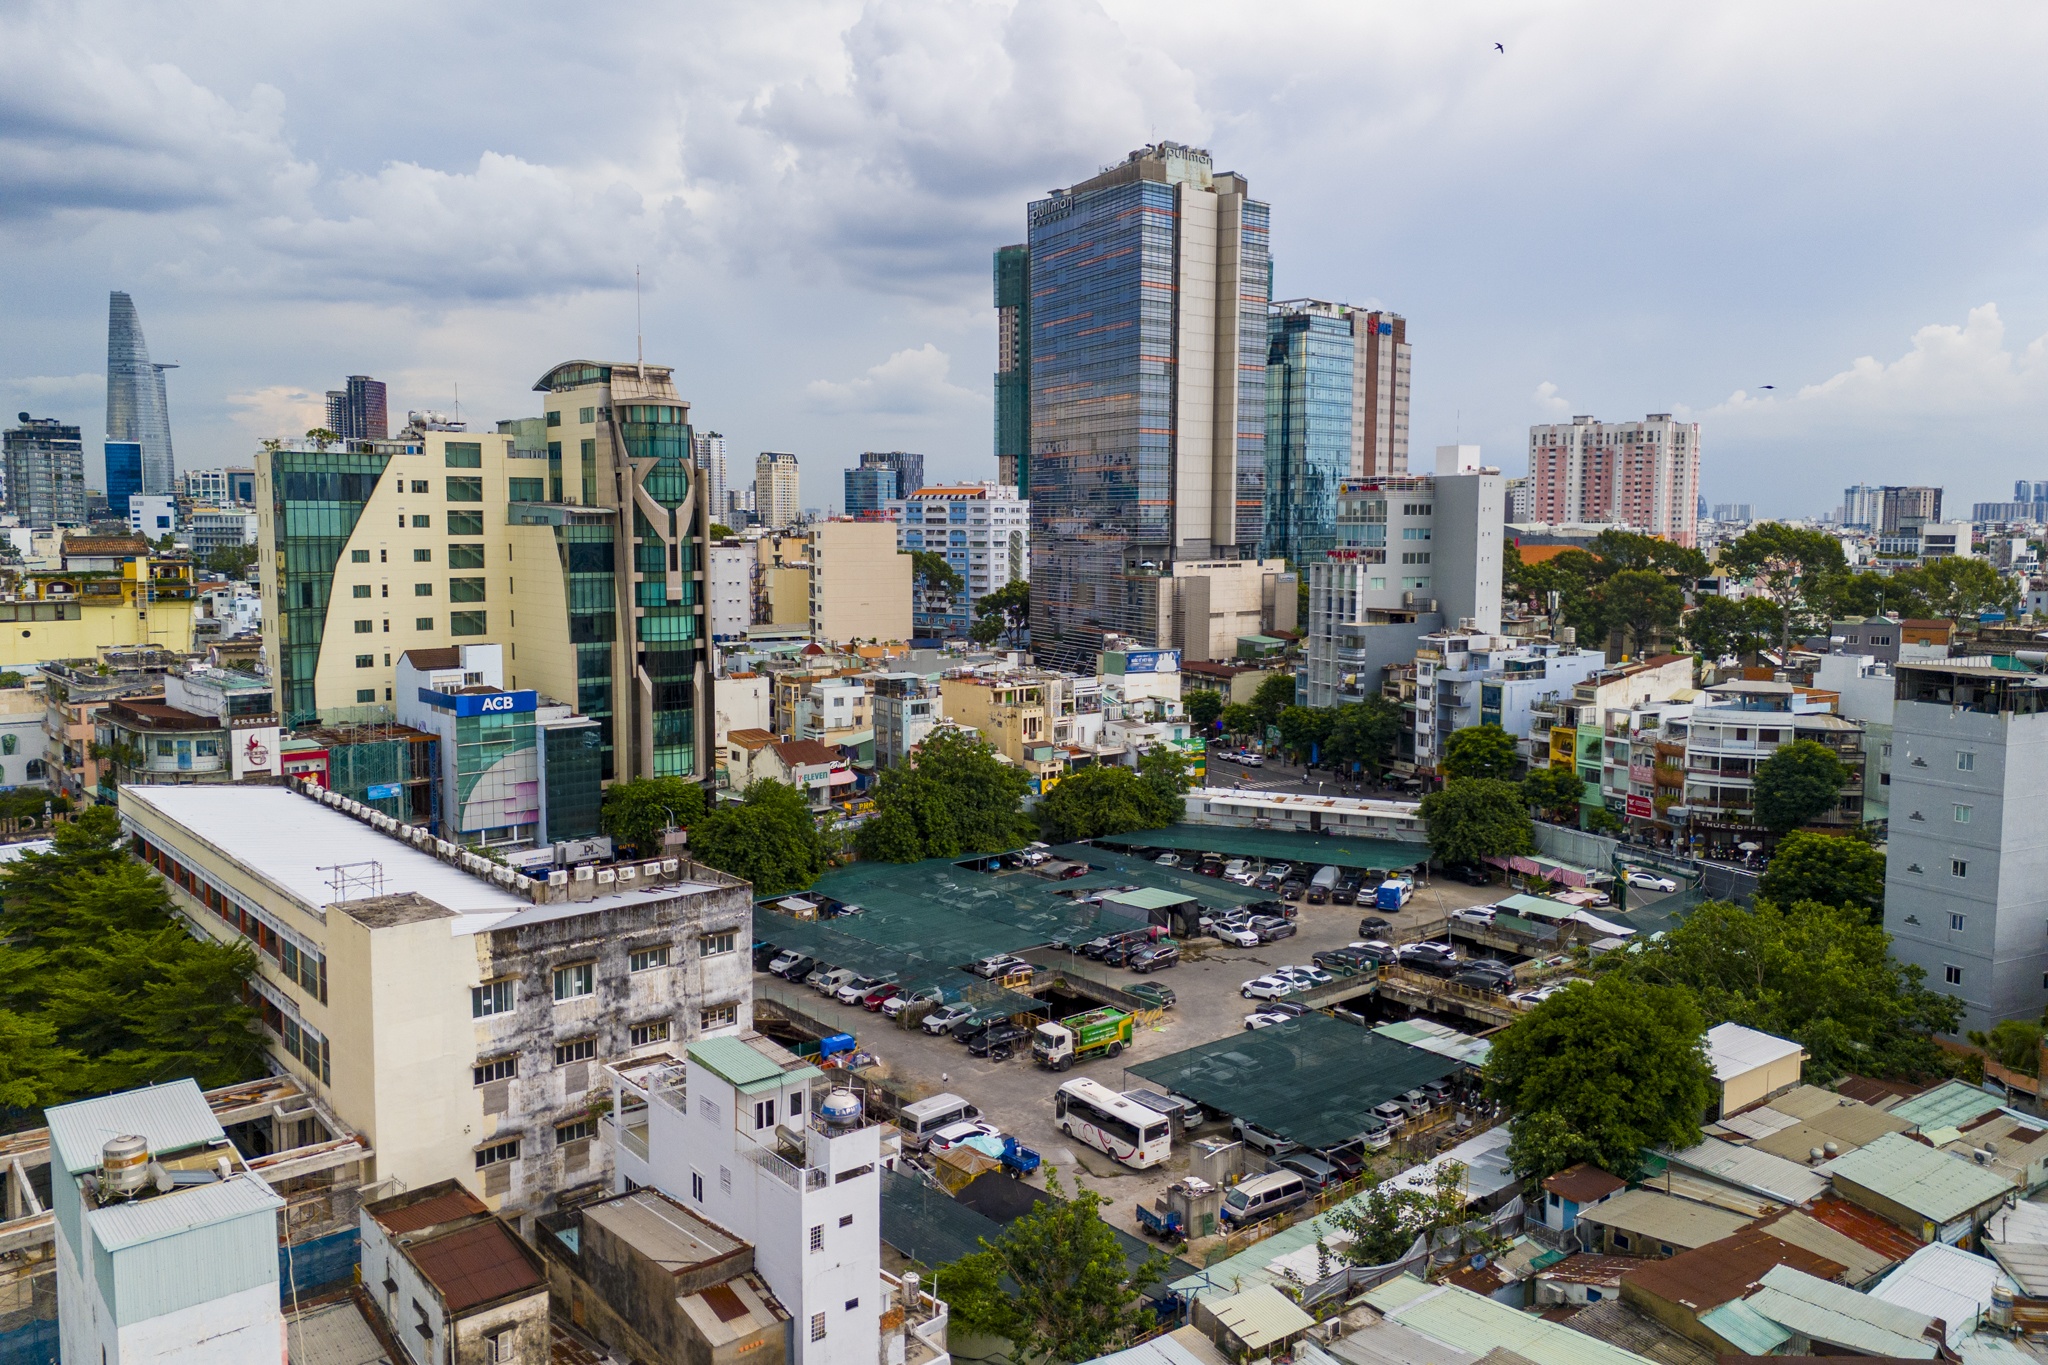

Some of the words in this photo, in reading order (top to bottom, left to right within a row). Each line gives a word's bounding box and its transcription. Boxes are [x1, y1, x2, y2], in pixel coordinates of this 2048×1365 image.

[1166, 147, 1213, 170] pullman
[1032, 196, 1073, 226] pullman
[481, 696, 514, 712] ACB
[1729, 824, 1769, 832] COFFEE
